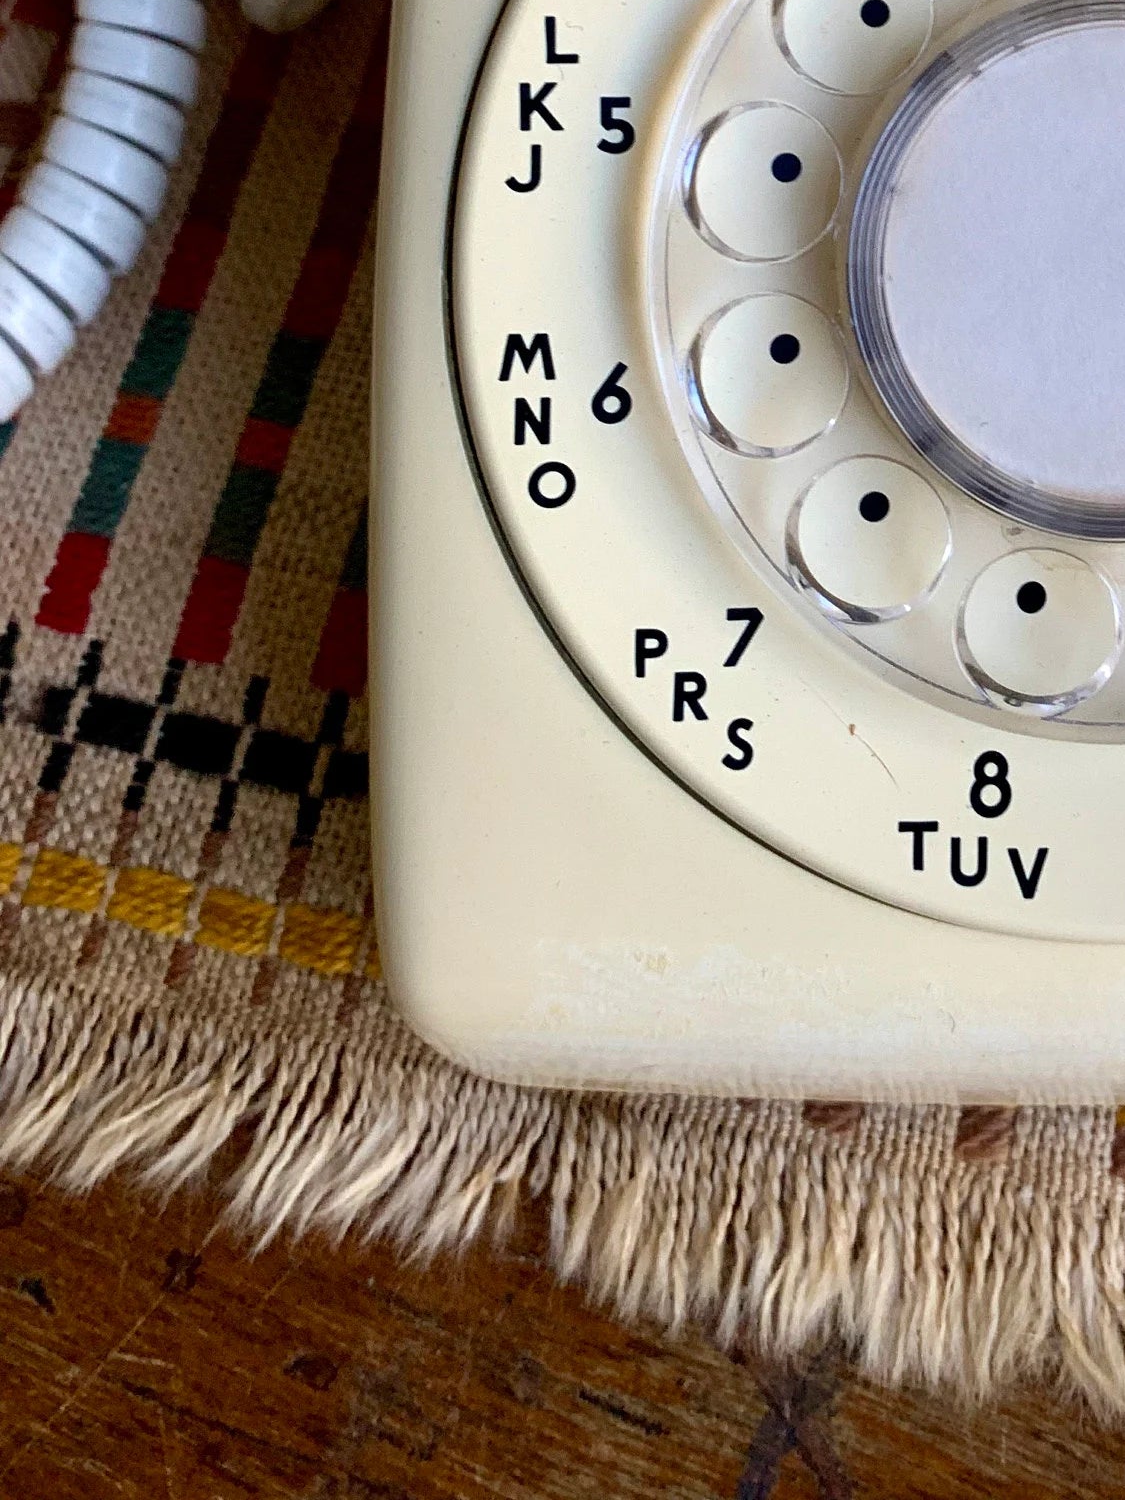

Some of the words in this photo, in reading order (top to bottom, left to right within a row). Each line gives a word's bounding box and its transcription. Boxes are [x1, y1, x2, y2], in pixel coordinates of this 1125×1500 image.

[596, 96, 637, 155] 5
[591, 361, 633, 425] 6
[722, 607, 765, 668] 7
[969, 750, 1012, 819] 8
[898, 820, 1049, 900] TUV
